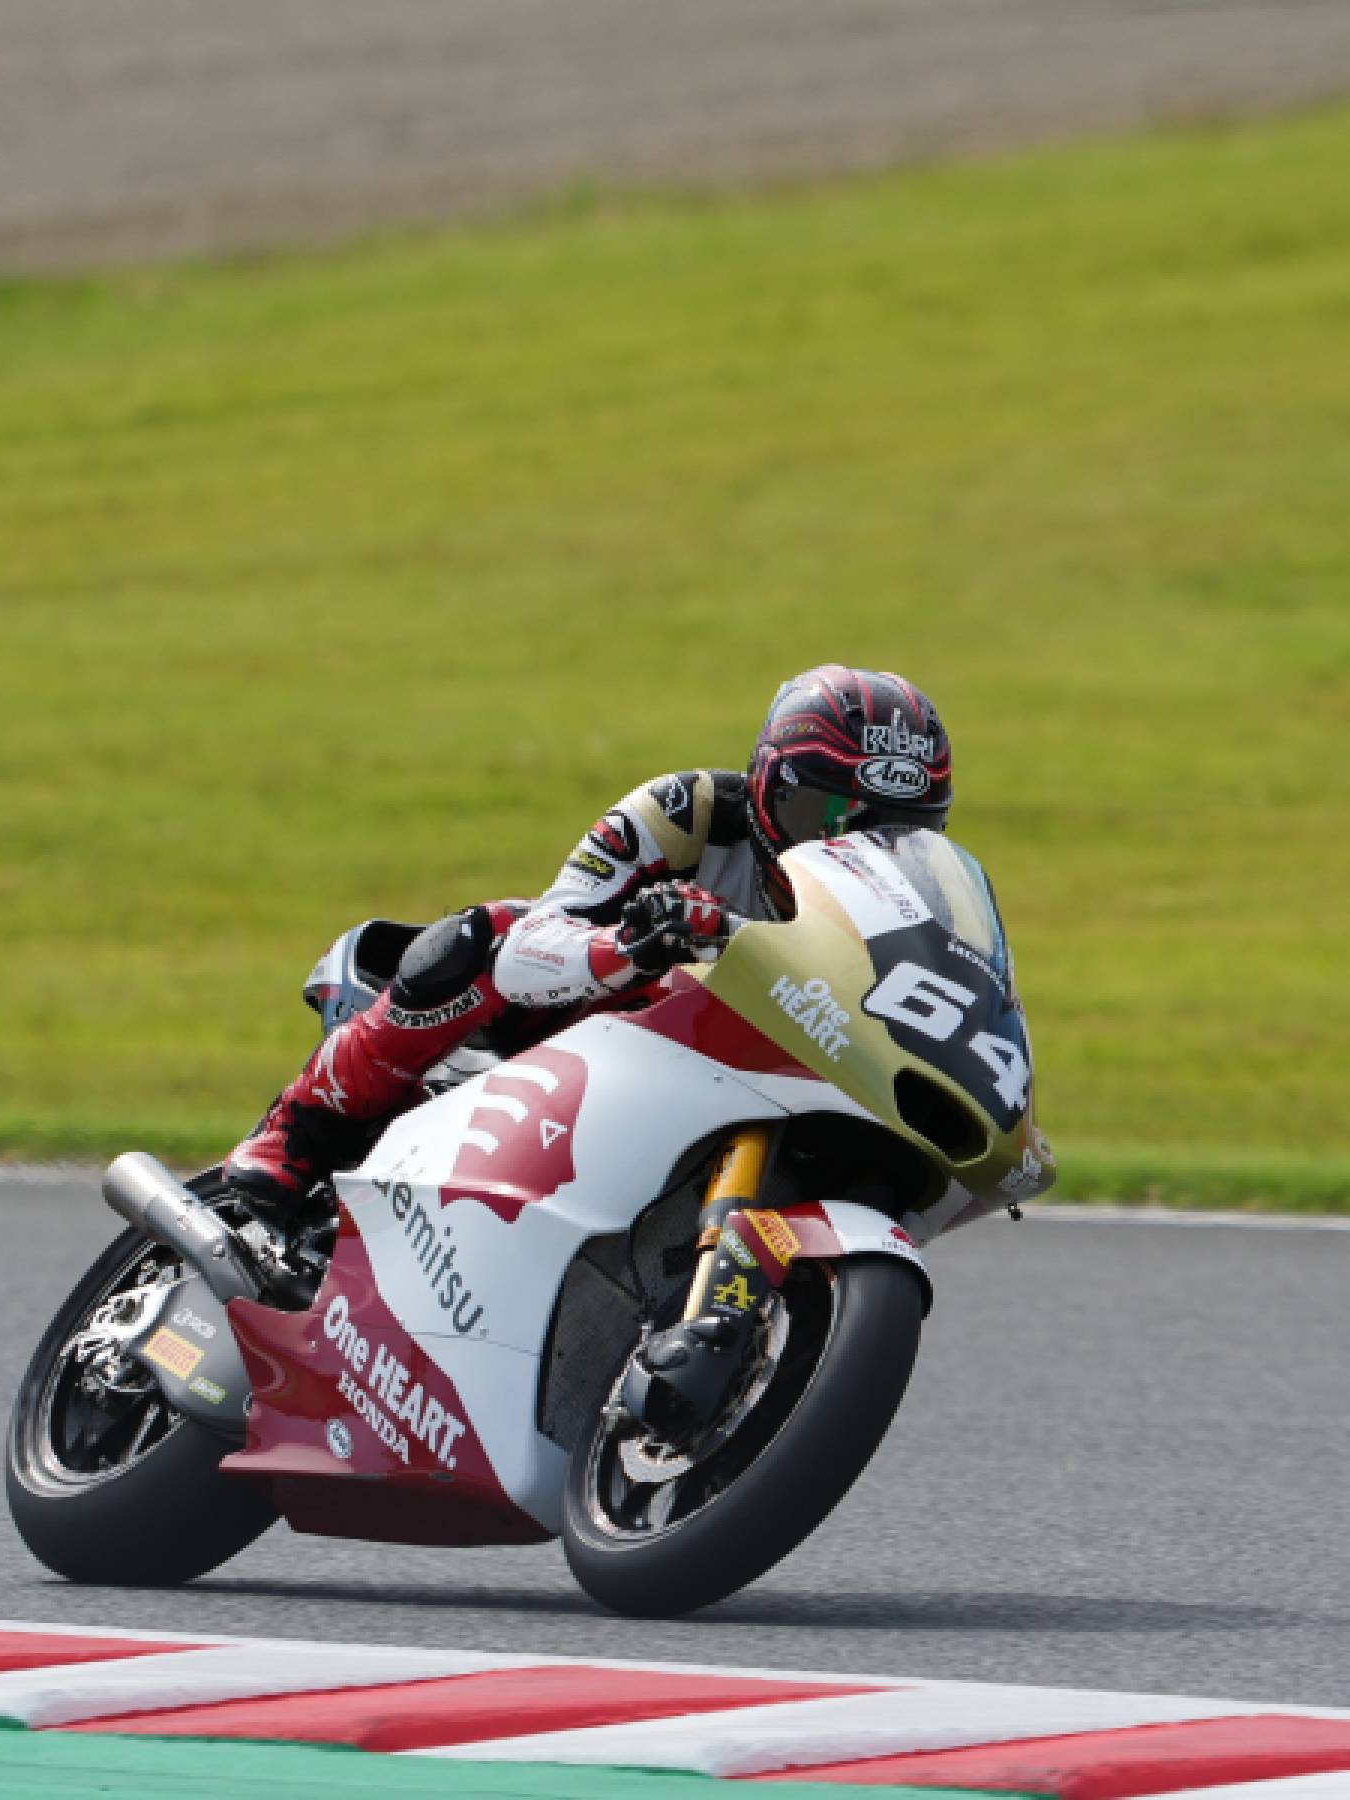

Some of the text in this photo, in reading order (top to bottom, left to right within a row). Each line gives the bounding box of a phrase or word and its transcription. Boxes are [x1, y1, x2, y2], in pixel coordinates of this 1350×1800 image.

[803, 979, 850, 1023] One
[864, 962, 1029, 1110] 64
[324, 1296, 369, 1373] One
